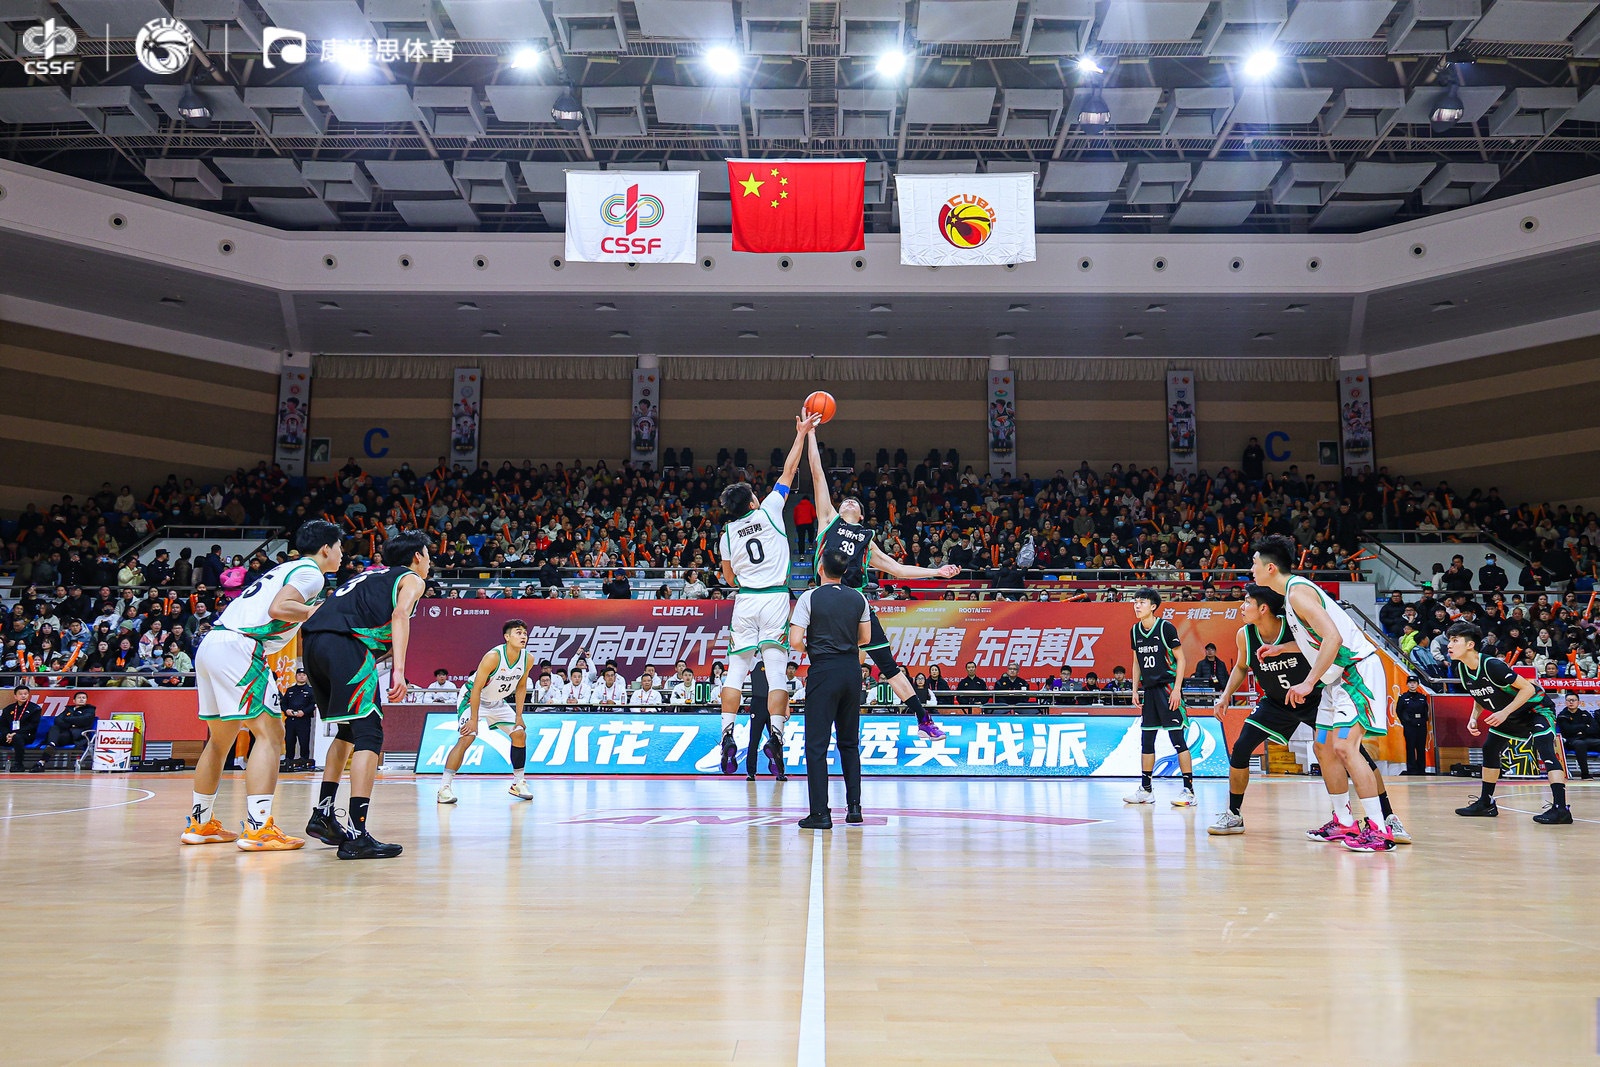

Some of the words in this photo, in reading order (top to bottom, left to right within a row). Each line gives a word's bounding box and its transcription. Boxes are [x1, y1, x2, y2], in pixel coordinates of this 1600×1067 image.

[601, 237, 662, 254] CSSF
[363, 427, 390, 459] C
[1264, 431, 1291, 462] C
[746, 538, 764, 564] 0
[839, 541, 855, 556] 39
[652, 606, 704, 617] CUBAL
[1162, 608, 1237, 619] 这一刻胜一切
[973, 626, 1104, 668] 东南赛区
[1143, 656, 1156, 668] 20
[1260, 657, 1298, 672] 华侨大学
[498, 684, 511, 692] 34
[1277, 674, 1291, 689] 5
[1483, 698, 1495, 709] 7
[529, 719, 699, 766] 水花7
